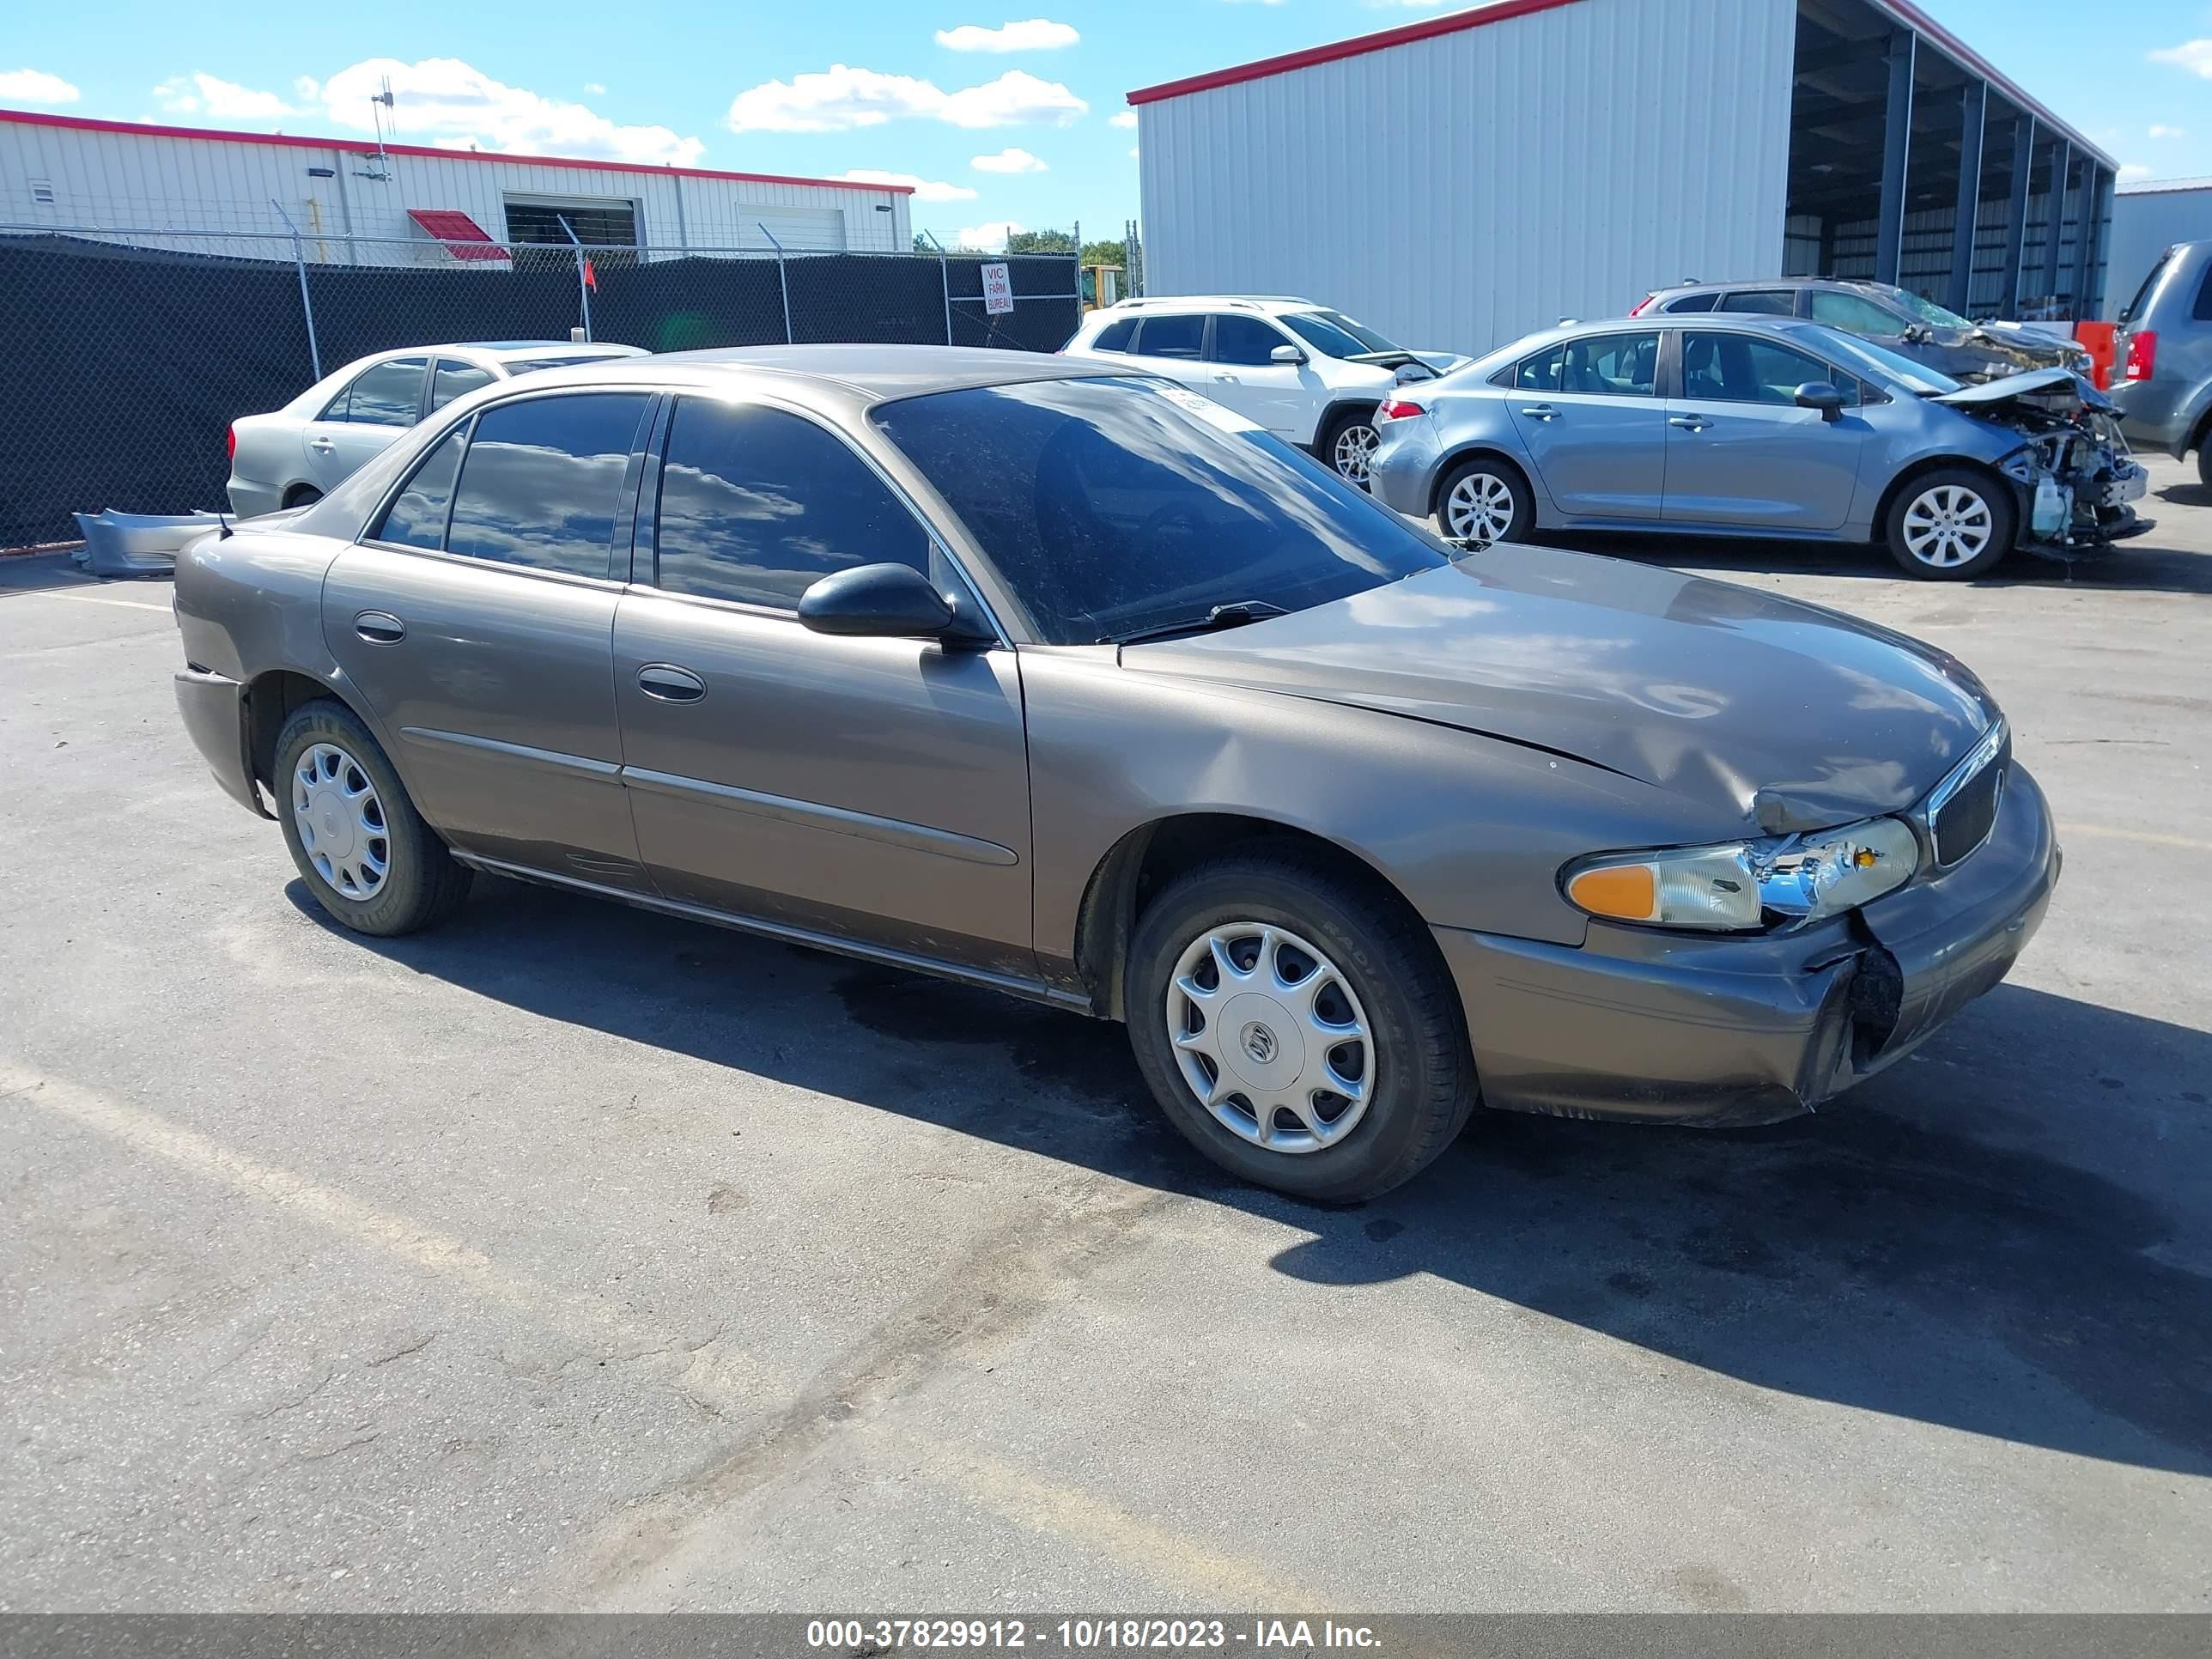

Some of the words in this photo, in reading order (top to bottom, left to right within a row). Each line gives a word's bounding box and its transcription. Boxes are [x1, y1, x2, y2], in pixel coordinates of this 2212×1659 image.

[987, 268, 1004, 279] VIC
[989, 283, 1006, 295] FARM
[988, 297, 1011, 310] BUREAU
